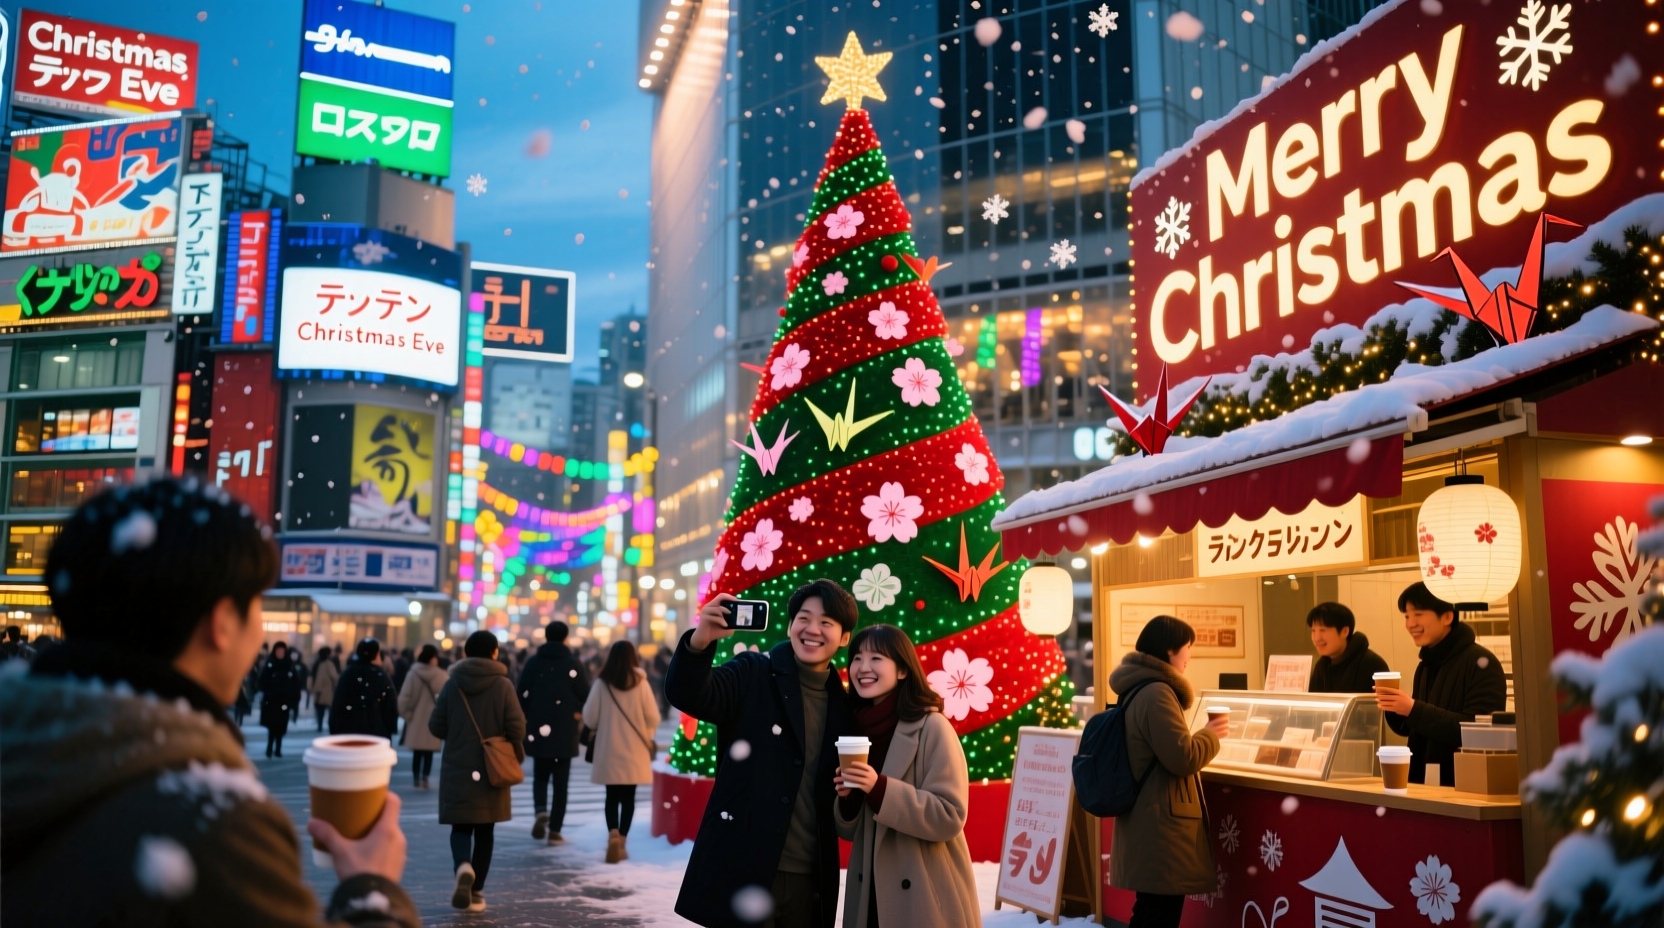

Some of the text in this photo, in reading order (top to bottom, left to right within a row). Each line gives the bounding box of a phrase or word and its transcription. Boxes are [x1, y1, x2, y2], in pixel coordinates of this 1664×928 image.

[120, 68, 180, 105] Eve
[1206, 23, 1466, 242] Merry
[1150, 99, 1612, 363] Christmas
[298, 322, 445, 354] Christmas Eve
